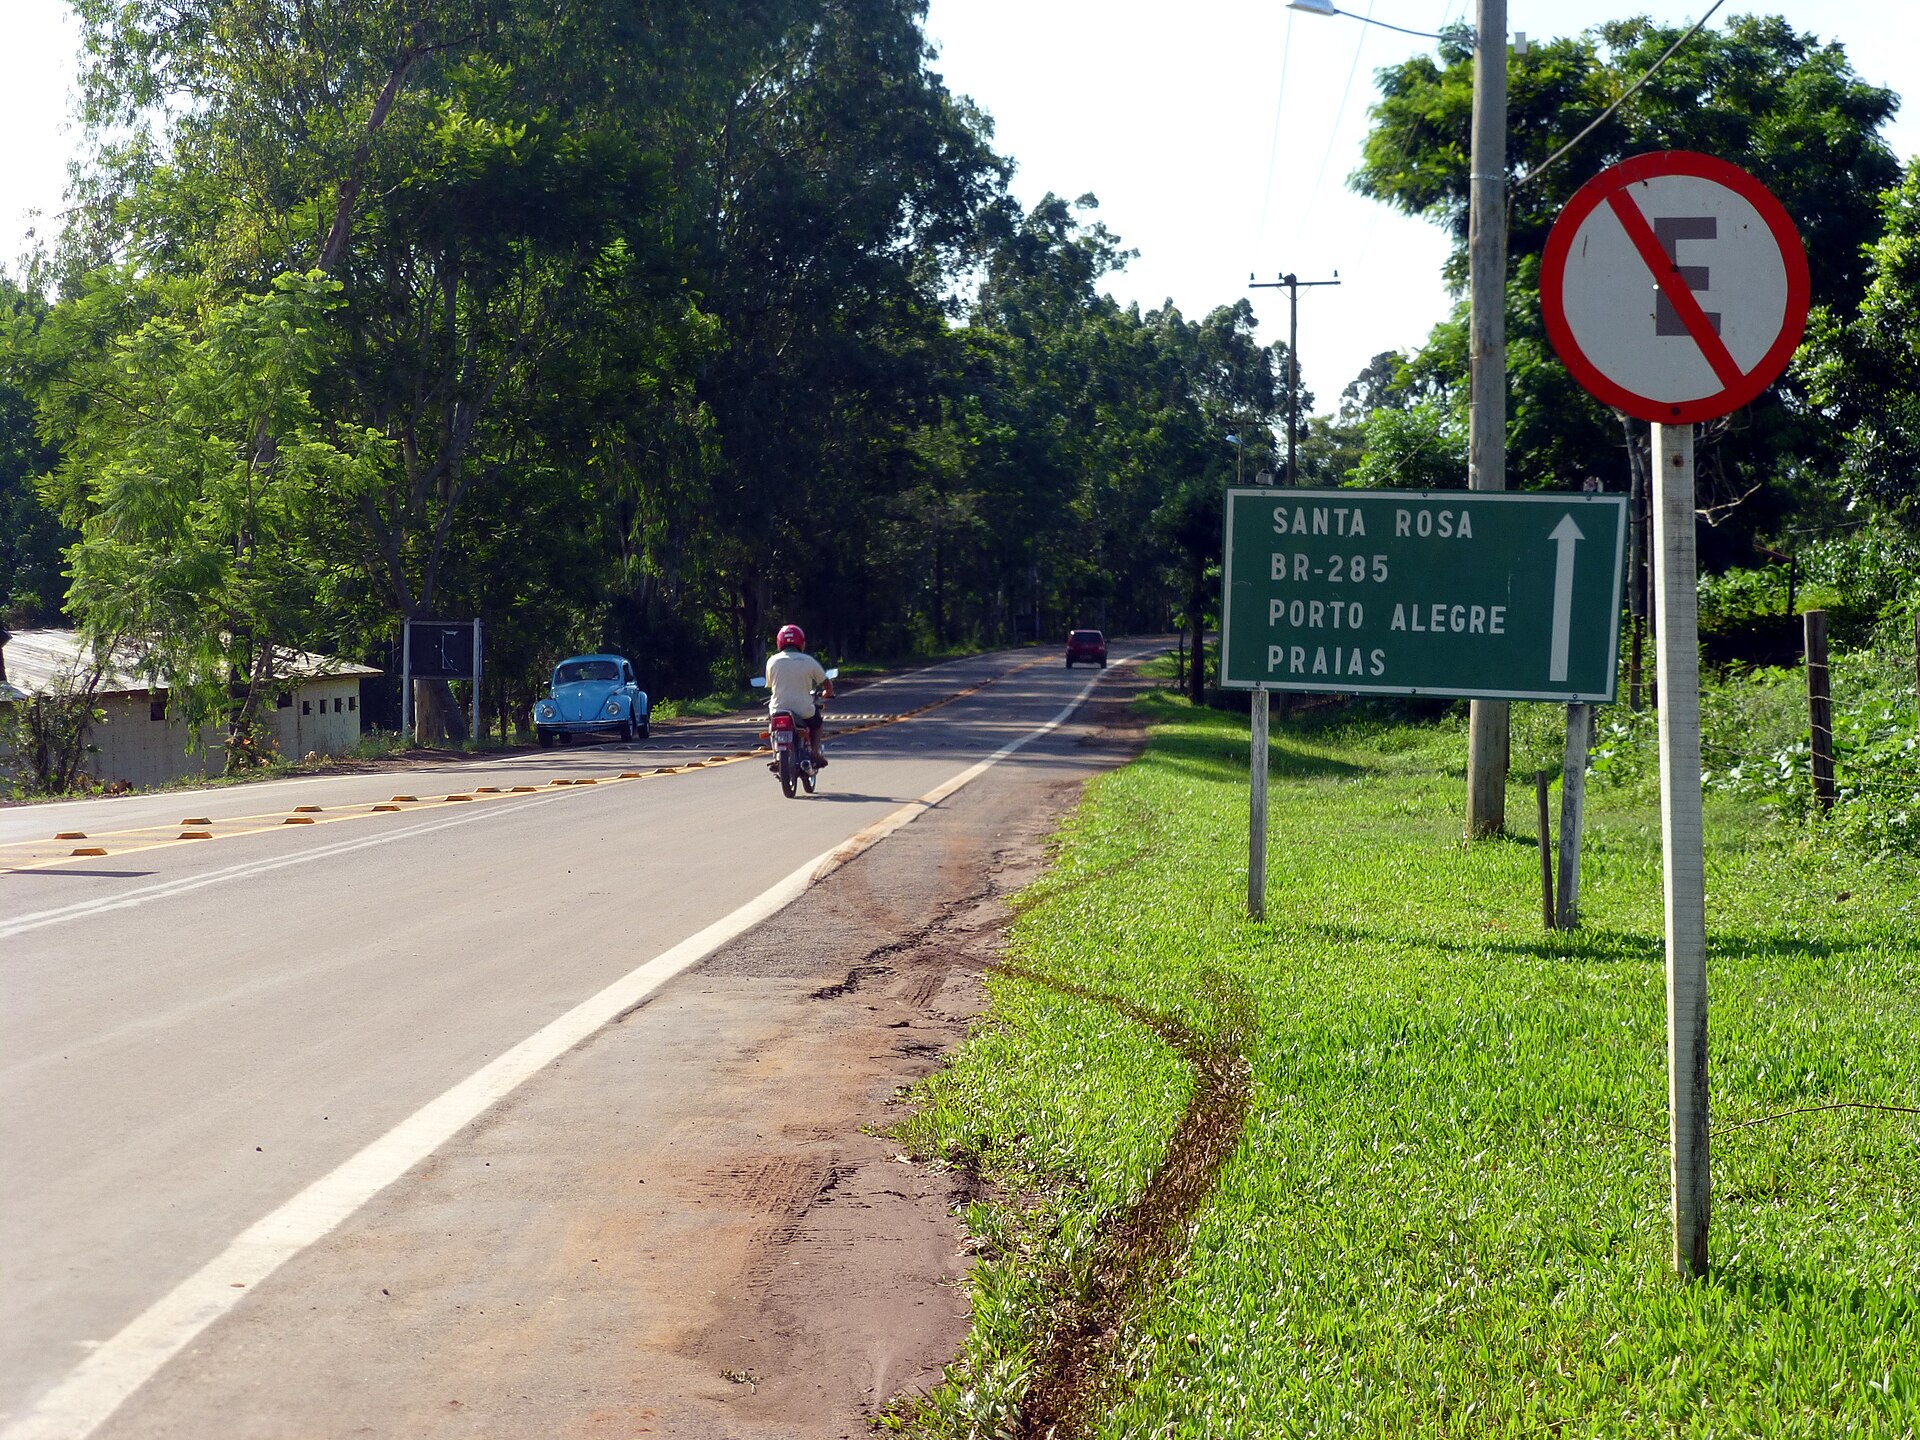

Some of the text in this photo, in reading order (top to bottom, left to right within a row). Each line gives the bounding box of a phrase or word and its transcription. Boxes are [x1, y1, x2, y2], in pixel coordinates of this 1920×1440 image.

[1654, 217, 1722, 336] E
[1272, 506, 1473, 539] SANTA ROSA
[1271, 552, 1389, 583] BR-285
[1269, 598, 1507, 635] PORTO ALEGRE
[1267, 645, 1386, 677] PRAIAS
